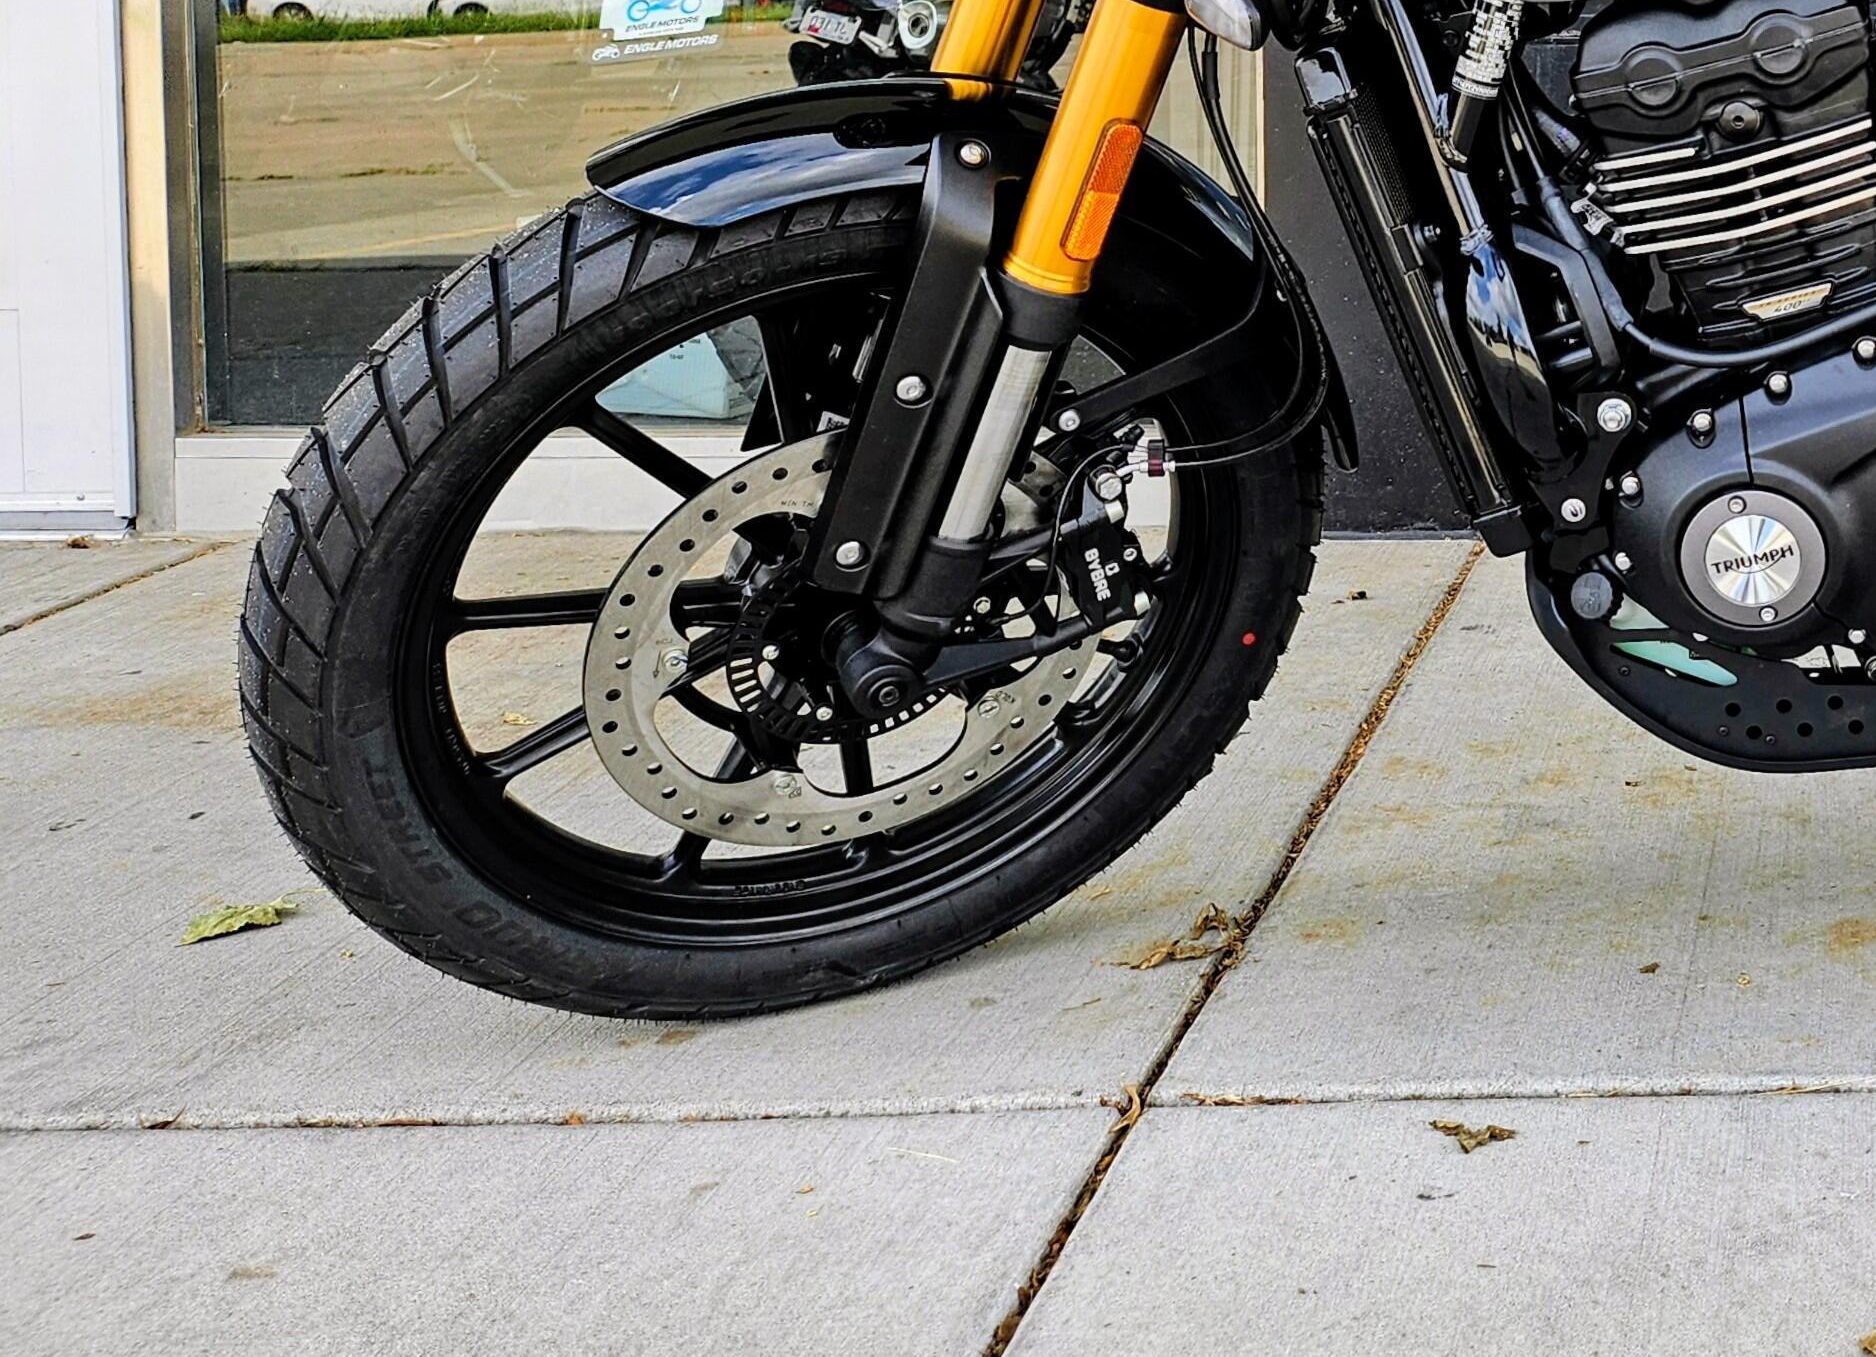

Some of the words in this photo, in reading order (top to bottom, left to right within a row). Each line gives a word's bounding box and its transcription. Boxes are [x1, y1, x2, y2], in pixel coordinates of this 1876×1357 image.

[625, 20, 657, 33] ENGLE
[657, 16, 699, 27] MOTORS
[624, 40, 664, 55] ENGLE
[664, 34, 719, 50] MOTORS
[1711, 544, 1796, 575] TRIUMPH
[1084, 547, 1112, 602] BYBRE
